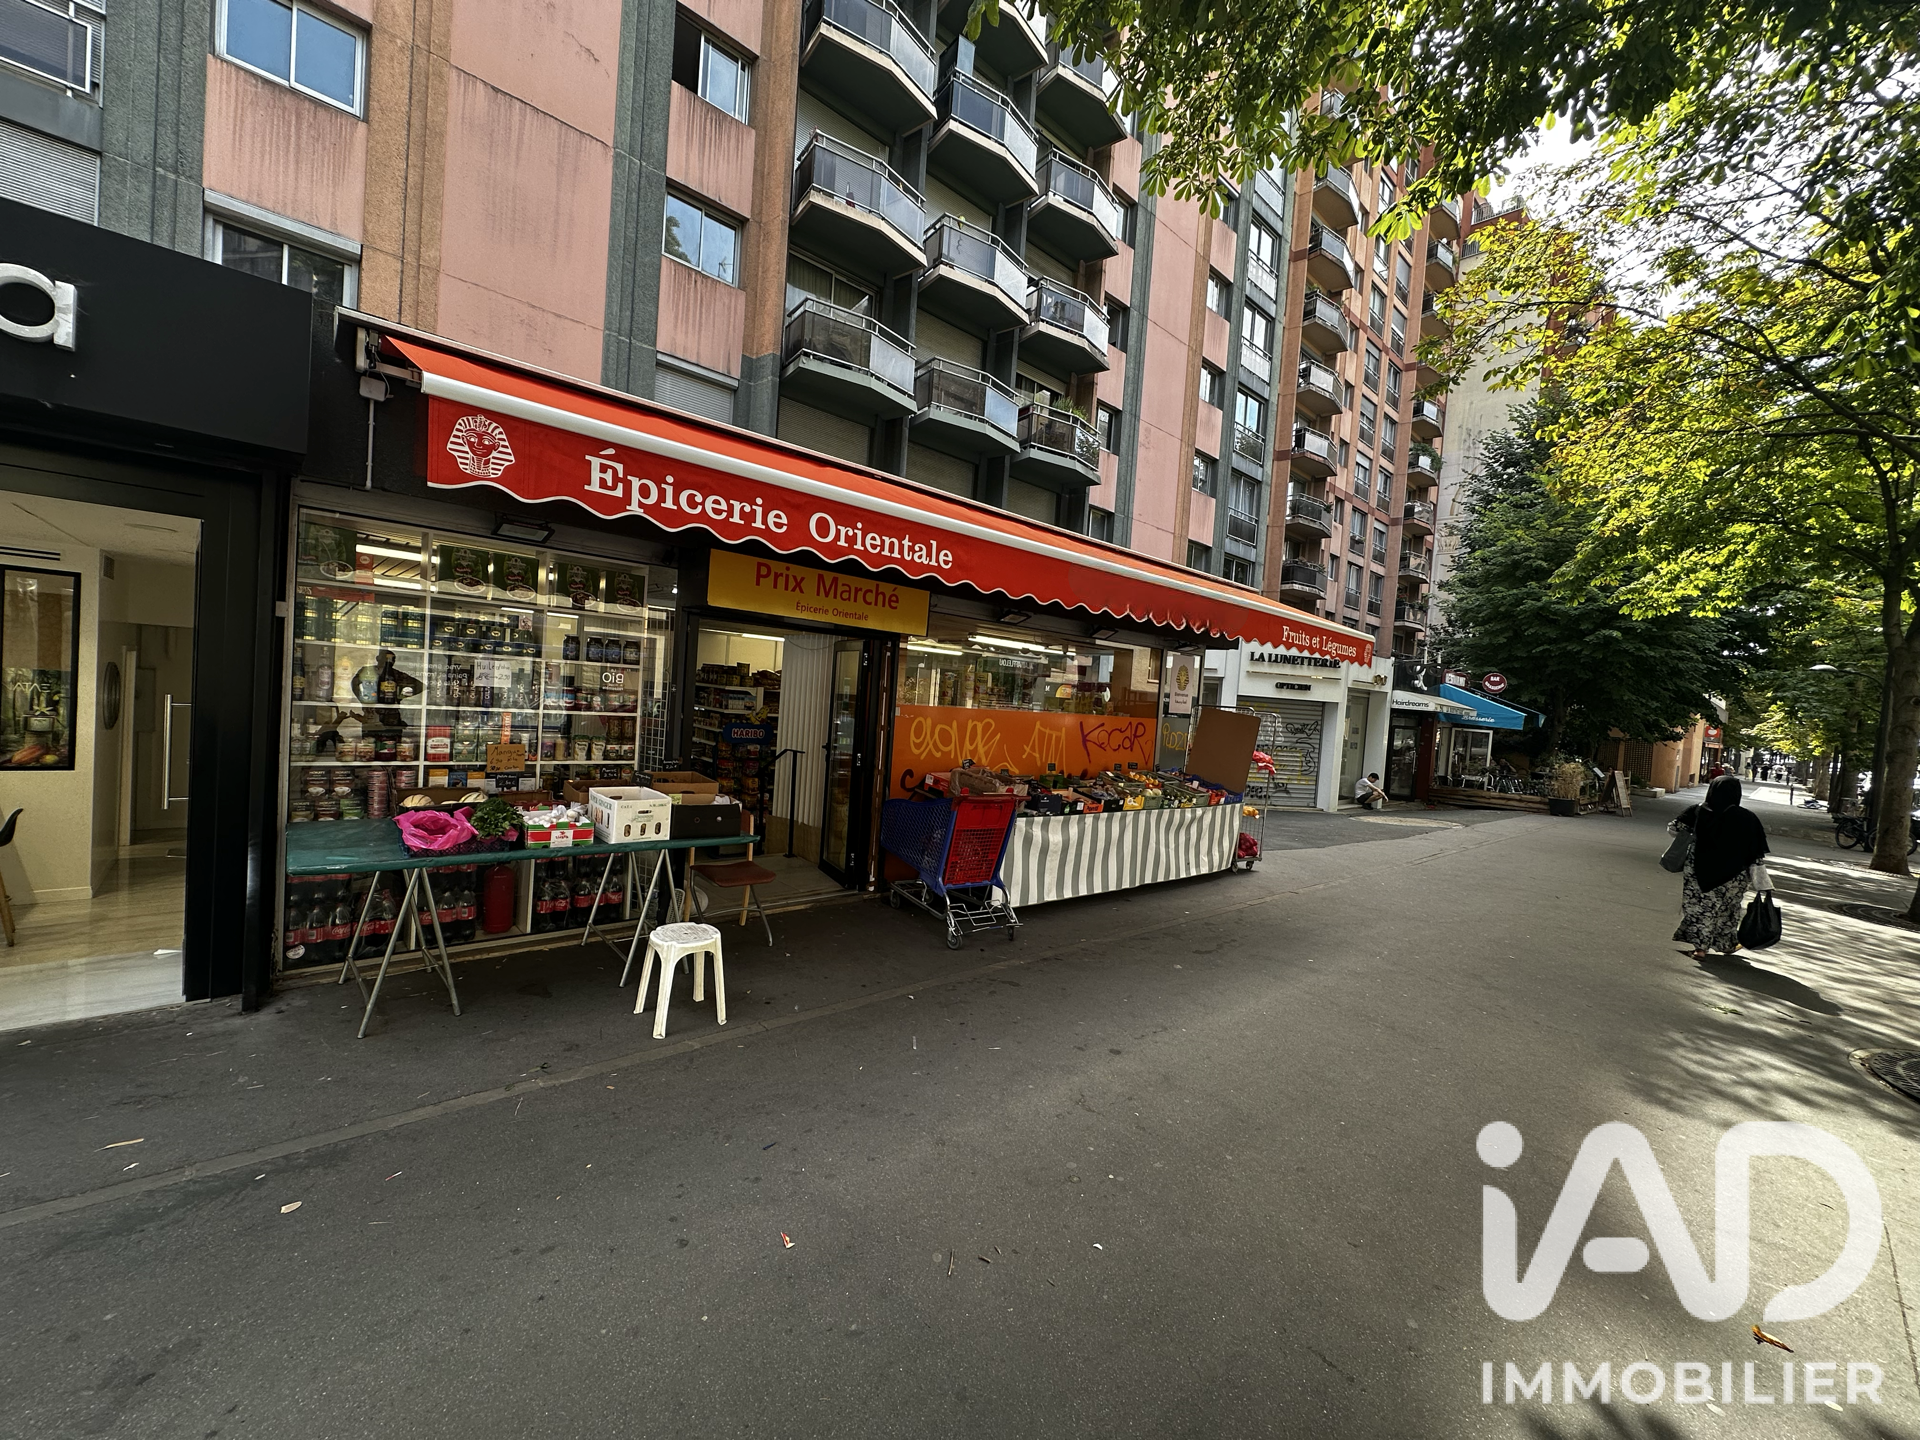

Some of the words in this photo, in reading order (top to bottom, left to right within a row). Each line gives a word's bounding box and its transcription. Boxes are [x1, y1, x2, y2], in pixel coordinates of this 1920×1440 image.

[583, 447, 790, 534] Épicerie
[808, 512, 954, 570] Orientale
[754, 561, 806, 595] Prix
[815, 572, 900, 610] Marché
[795, 600, 830, 616] Épicerie
[831, 608, 869, 622] Orientale
[1282, 625, 1310, 647] Fruits
[1311, 635, 1320, 649] et
[1322, 635, 1357, 658] Légumes
[1250, 651, 1266, 663] LA
[1267, 652, 1341, 669] LUNETTERIE
[1275, 682, 1312, 692] OPTICIEN
[1391, 699, 1430, 708] Hairdreams
[731, 727, 766, 739] HARIBO
